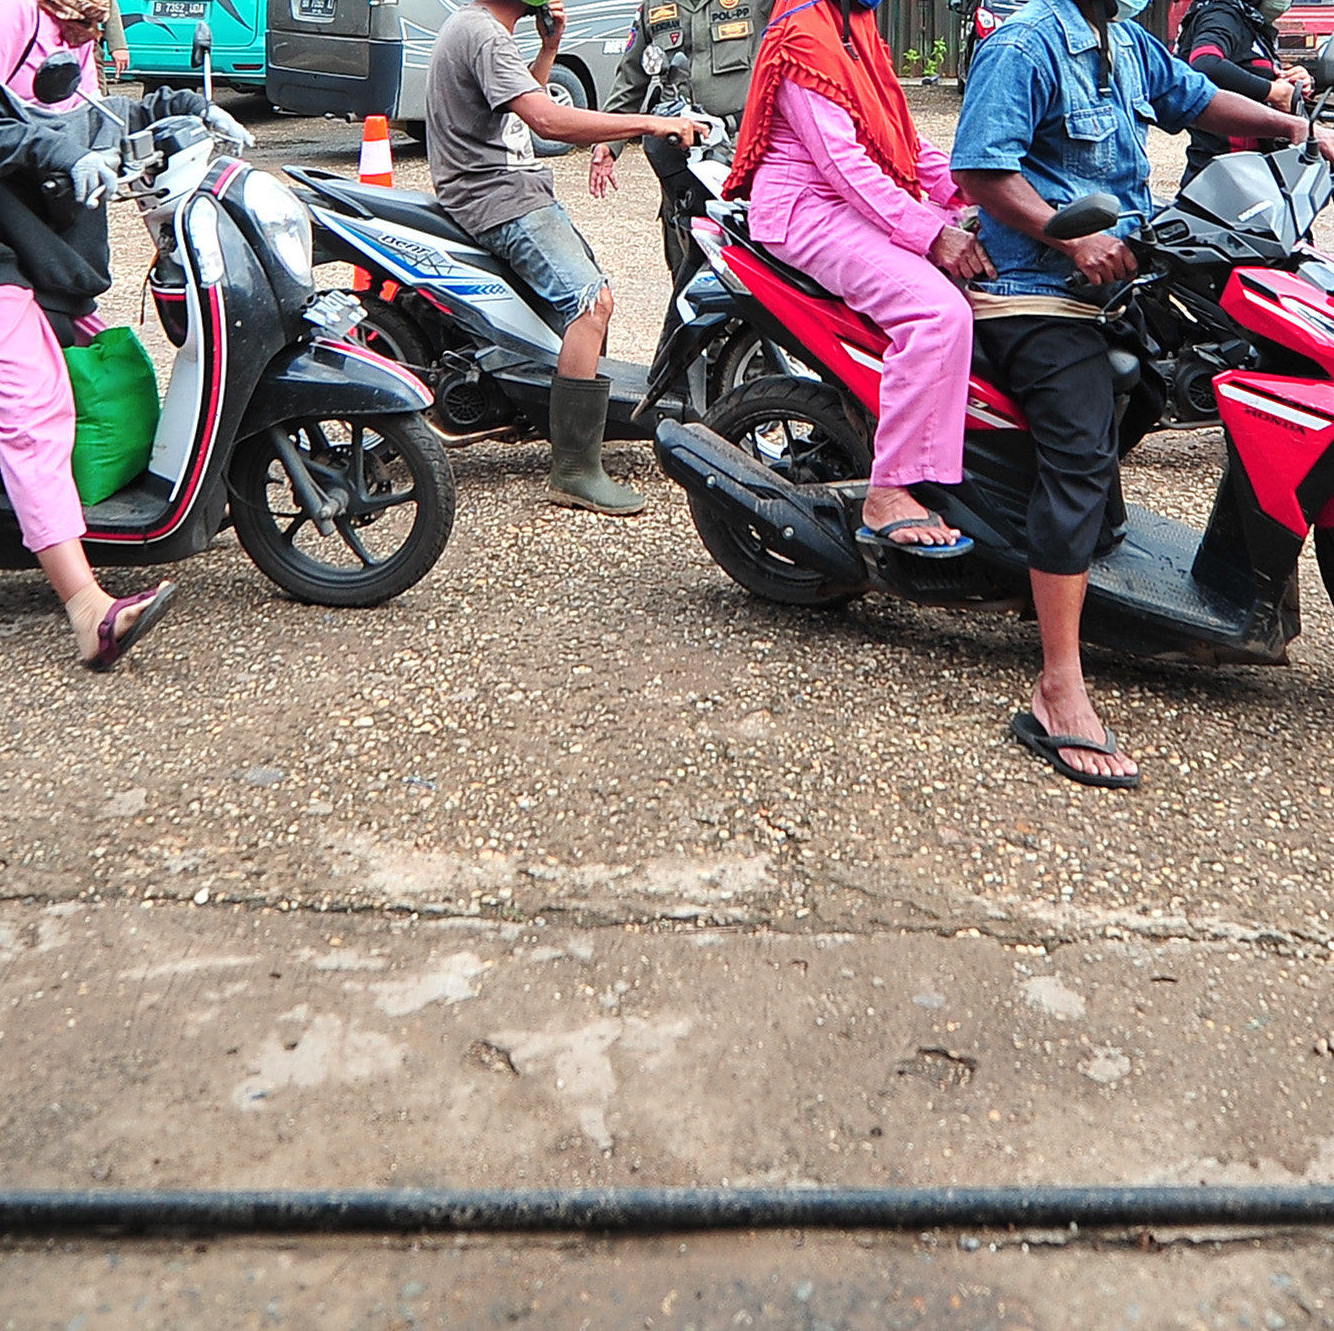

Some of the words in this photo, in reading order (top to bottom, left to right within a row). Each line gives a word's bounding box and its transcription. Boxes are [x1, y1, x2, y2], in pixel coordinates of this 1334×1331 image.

[155, 2, 162, 13] B
[712, 8, 749, 22] POL-PP
[1245, 408, 1306, 435] HONDA
